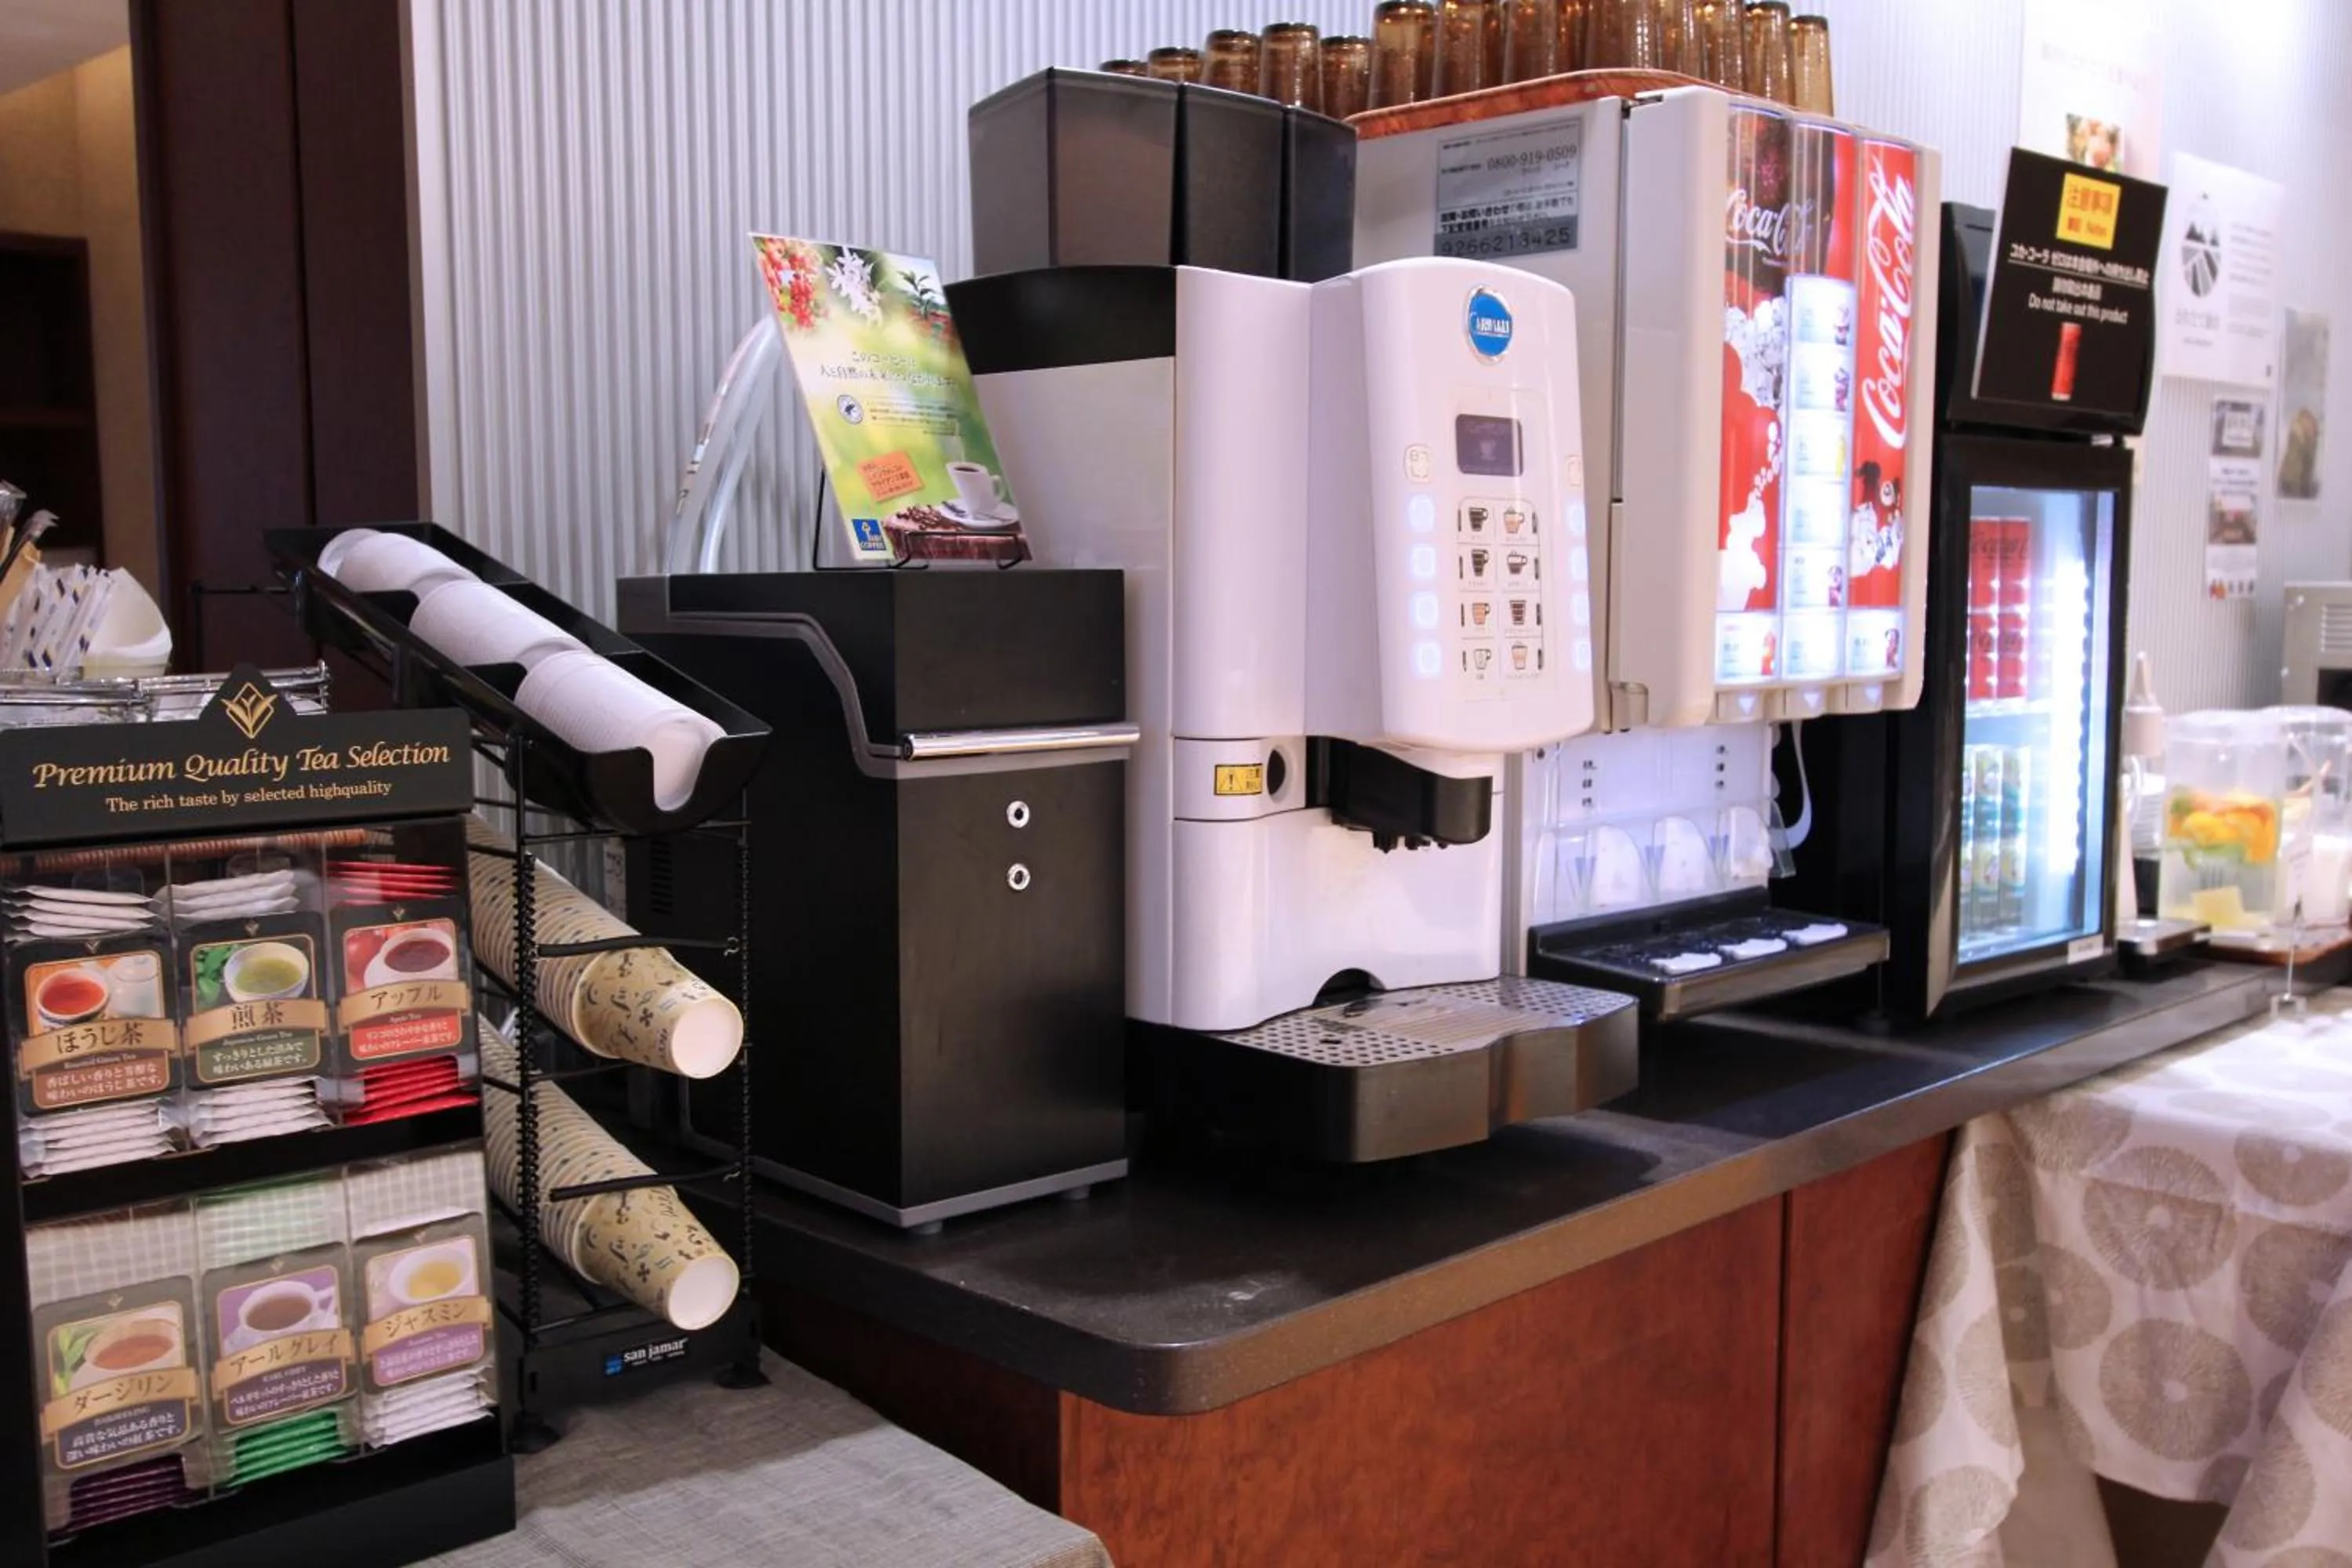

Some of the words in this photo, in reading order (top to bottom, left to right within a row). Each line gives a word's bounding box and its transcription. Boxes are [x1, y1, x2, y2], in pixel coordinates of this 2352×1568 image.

[1862, 154, 1914, 449] Coca-Cola
[2028, 292, 2041, 309] Do
[32, 757, 176, 788] Premium
[184, 748, 289, 782] Quality
[296, 745, 340, 771] Tea
[345, 742, 451, 768] Selection
[106, 797, 139, 813] The
[143, 794, 174, 810] rich
[179, 793, 218, 808] taste
[221, 789, 238, 807] by
[244, 785, 305, 802] selected
[309, 780, 392, 800] highquality
[230, 1002, 284, 1029] 煎茶
[56, 1022, 143, 1054] ほうじ茶
[386, 1304, 466, 1338] ジャスミン
[230, 1334, 338, 1376] アールグレイ
[623, 1348, 647, 1363] san
[648, 1338, 689, 1359] jamar
[74, 1375, 174, 1414] ダージリン
